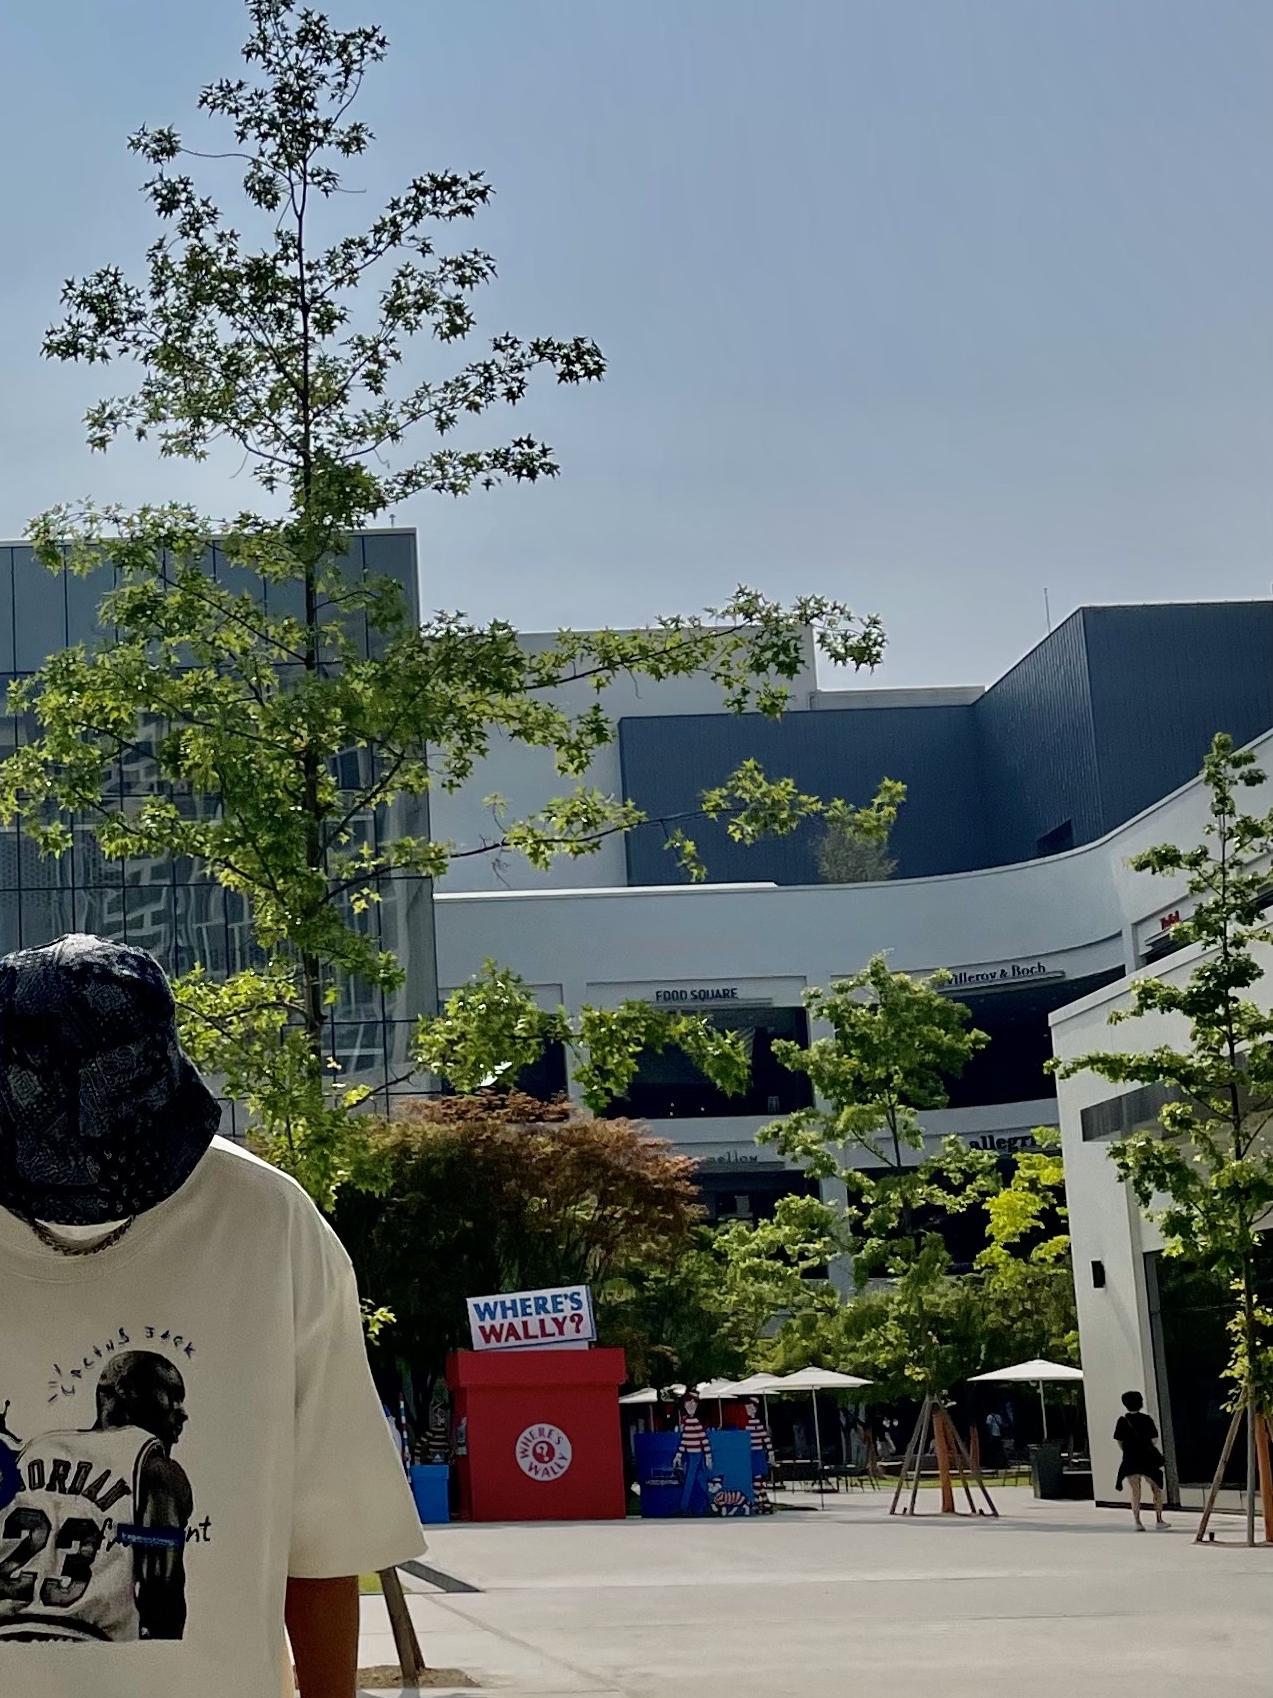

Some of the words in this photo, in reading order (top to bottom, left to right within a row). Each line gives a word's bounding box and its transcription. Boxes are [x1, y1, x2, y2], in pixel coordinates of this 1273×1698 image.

[999, 968, 1008, 978] &
[655, 989, 687, 1001] FOOD
[690, 987, 738, 1001] SQUARE
[473, 1291, 583, 1322] WHERE'S
[479, 1313, 584, 1344] WALLY?
[520, 1427, 564, 1459] WHERE'S
[528, 1453, 568, 1478] WALLY
[19, 1458, 132, 1512] ORDAN
